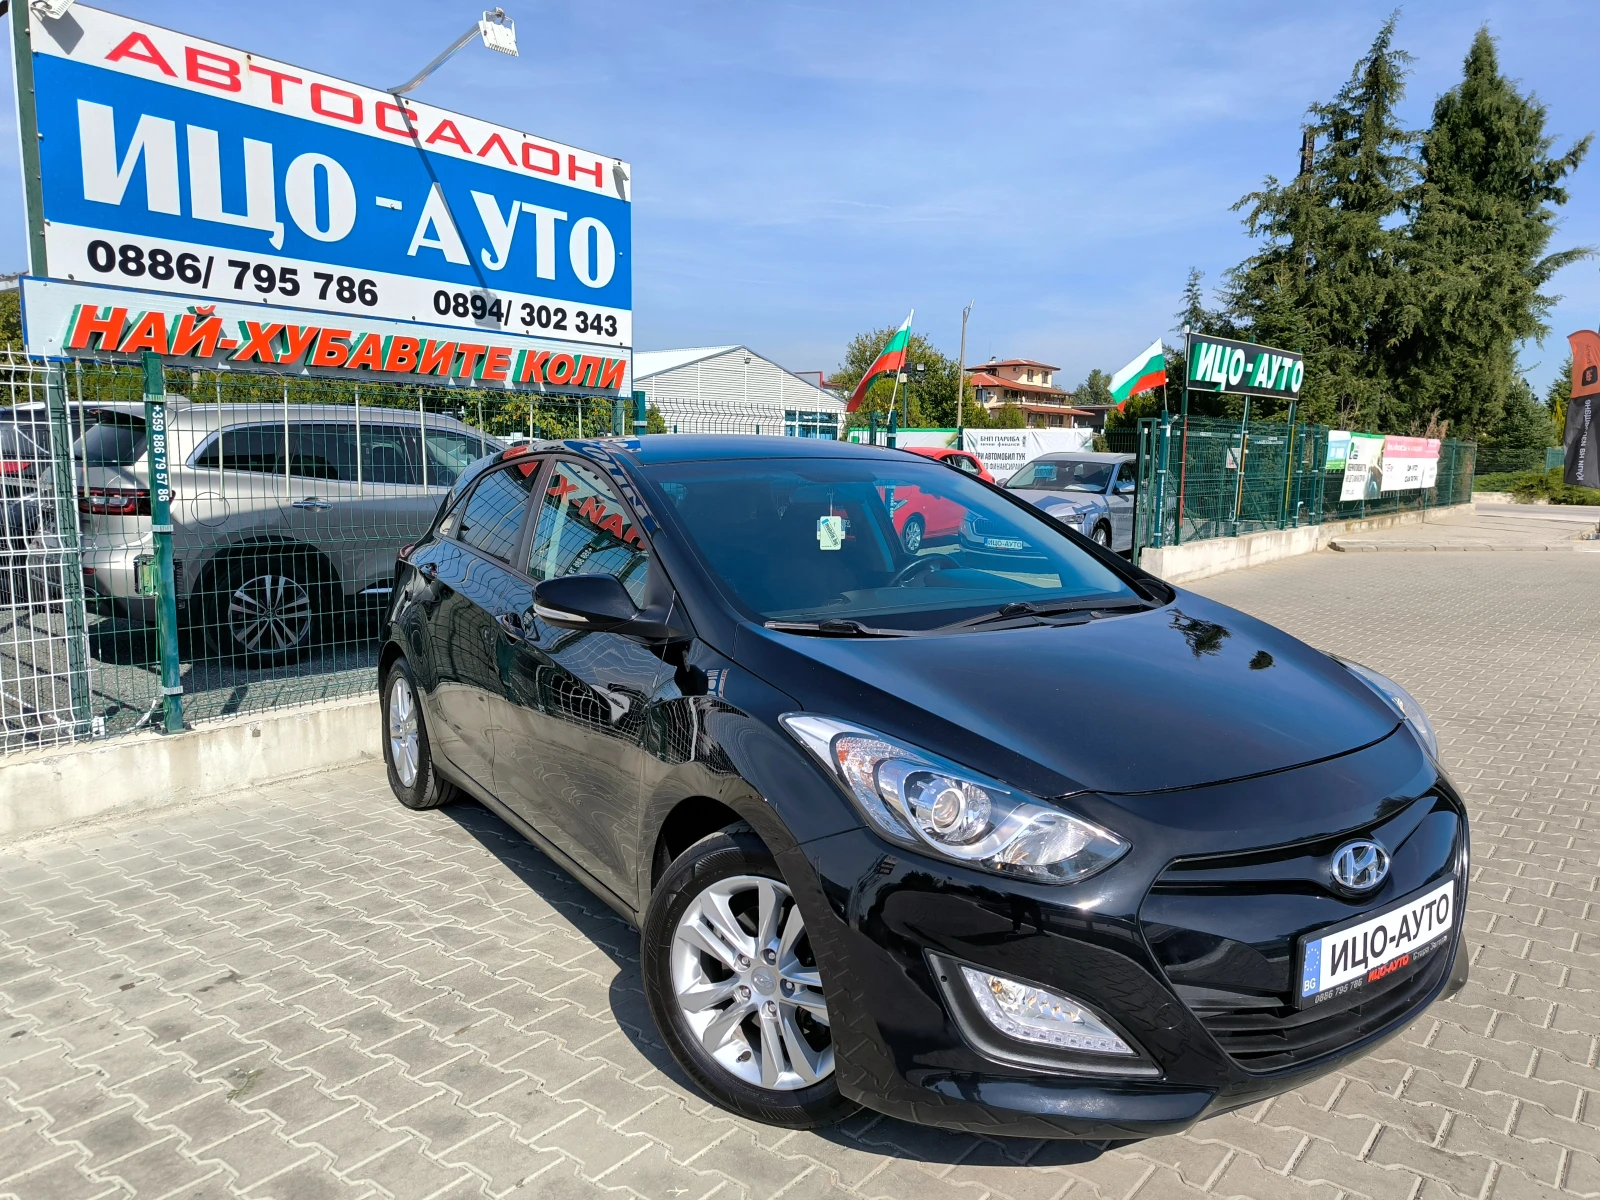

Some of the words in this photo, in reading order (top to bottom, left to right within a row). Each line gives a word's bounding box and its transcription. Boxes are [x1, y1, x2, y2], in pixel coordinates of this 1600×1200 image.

[105, 32, 603, 188] АВТОСАЛОН
[87, 240, 213, 289] 0886/
[229, 260, 300, 297] 795
[314, 273, 378, 307] 786
[433, 290, 512, 325] 0894/
[520, 303, 569, 331] 302
[575, 308, 617, 337] 343
[67, 304, 512, 382] НАЙ-ХУБАВИТЕ
[520, 350, 627, 390] КОЛИ
[1194, 342, 1304, 393] ИЦО-АУТО
[152, 404, 164, 432] +359
[153, 434, 166, 454] 886
[155, 456, 167, 470] 79
[156, 473, 168, 485] 57
[158, 488, 169, 502] 86
[1330, 893, 1450, 977] ИЦО-АУТО
[1368, 954, 1410, 982] ИЦО-АУТО
[1304, 978, 1316, 991] BG
[1314, 991, 1333, 1003] 0886
[1335, 983, 1349, 996] 795
